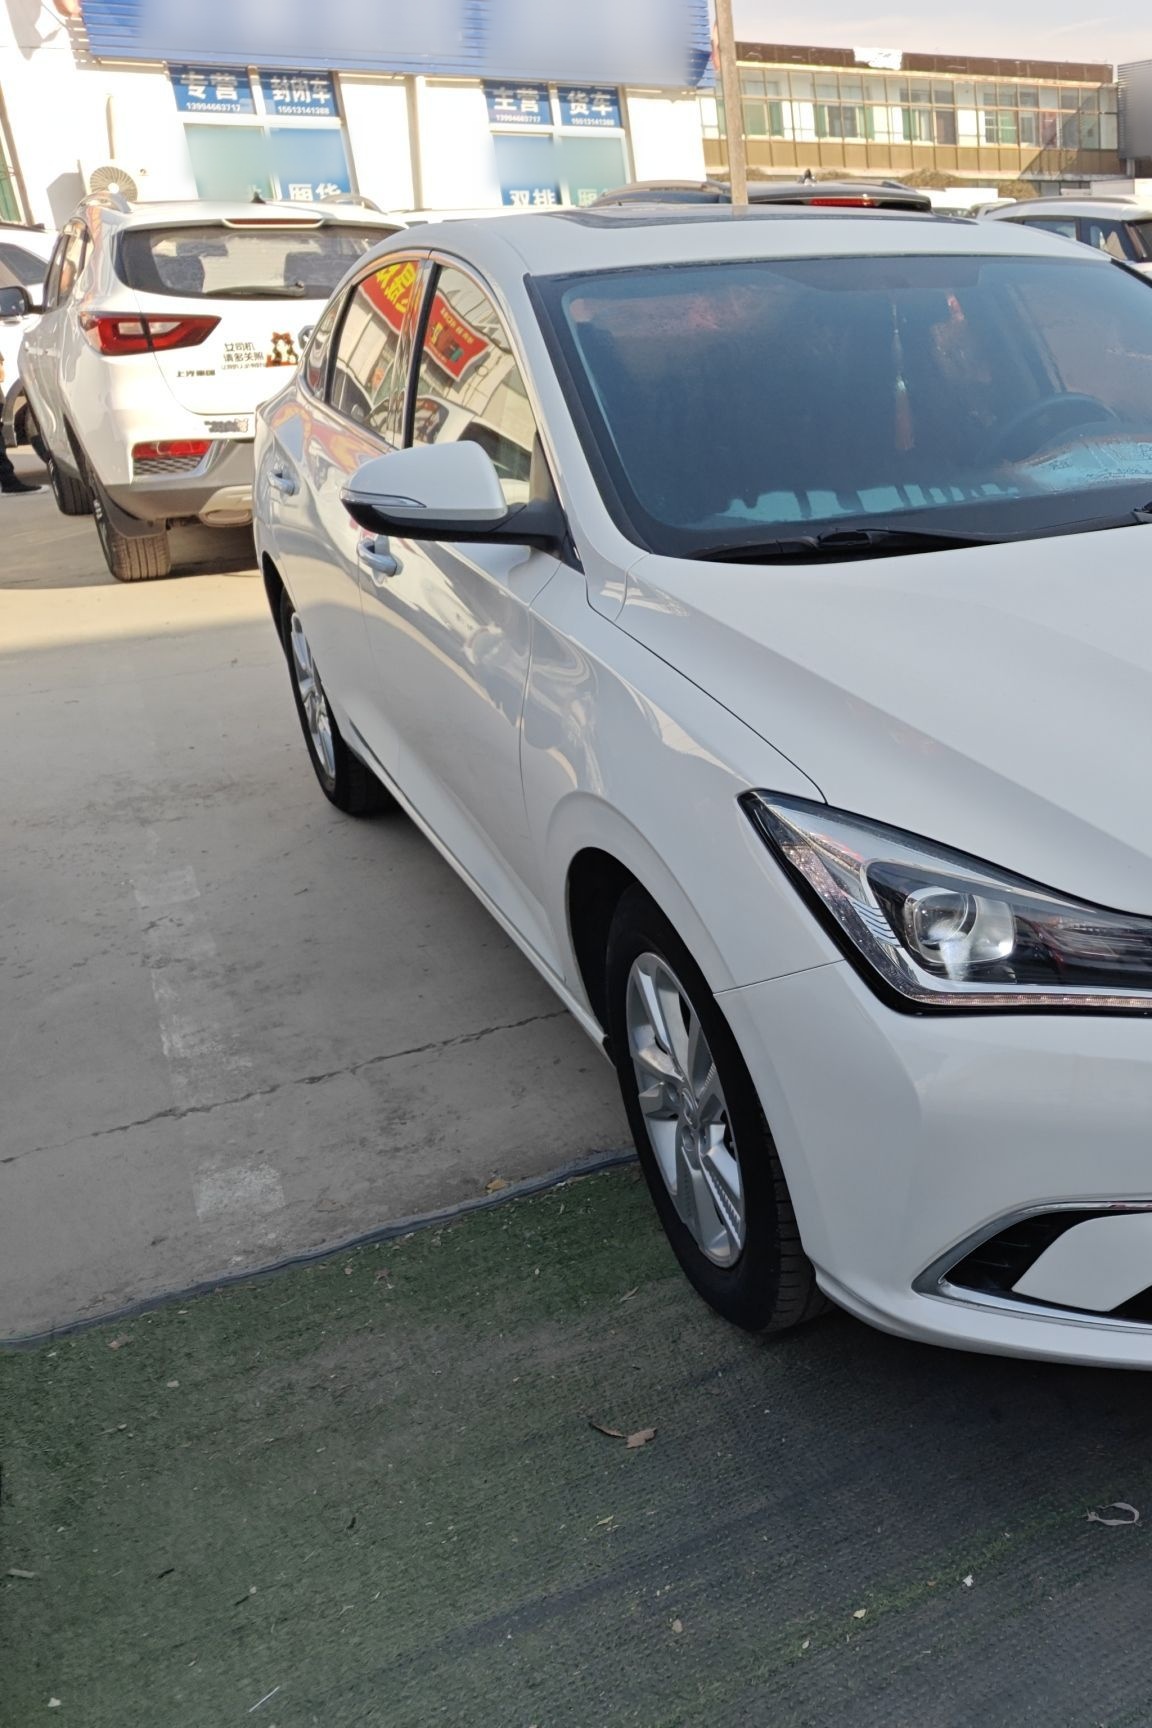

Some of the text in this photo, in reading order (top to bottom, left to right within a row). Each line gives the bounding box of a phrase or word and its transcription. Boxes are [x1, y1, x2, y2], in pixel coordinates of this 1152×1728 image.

[180, 71, 331, 104] 专营 封闭车
[492, 86, 613, 116] 主营 货车
[224, 342, 255, 352] 女司机
